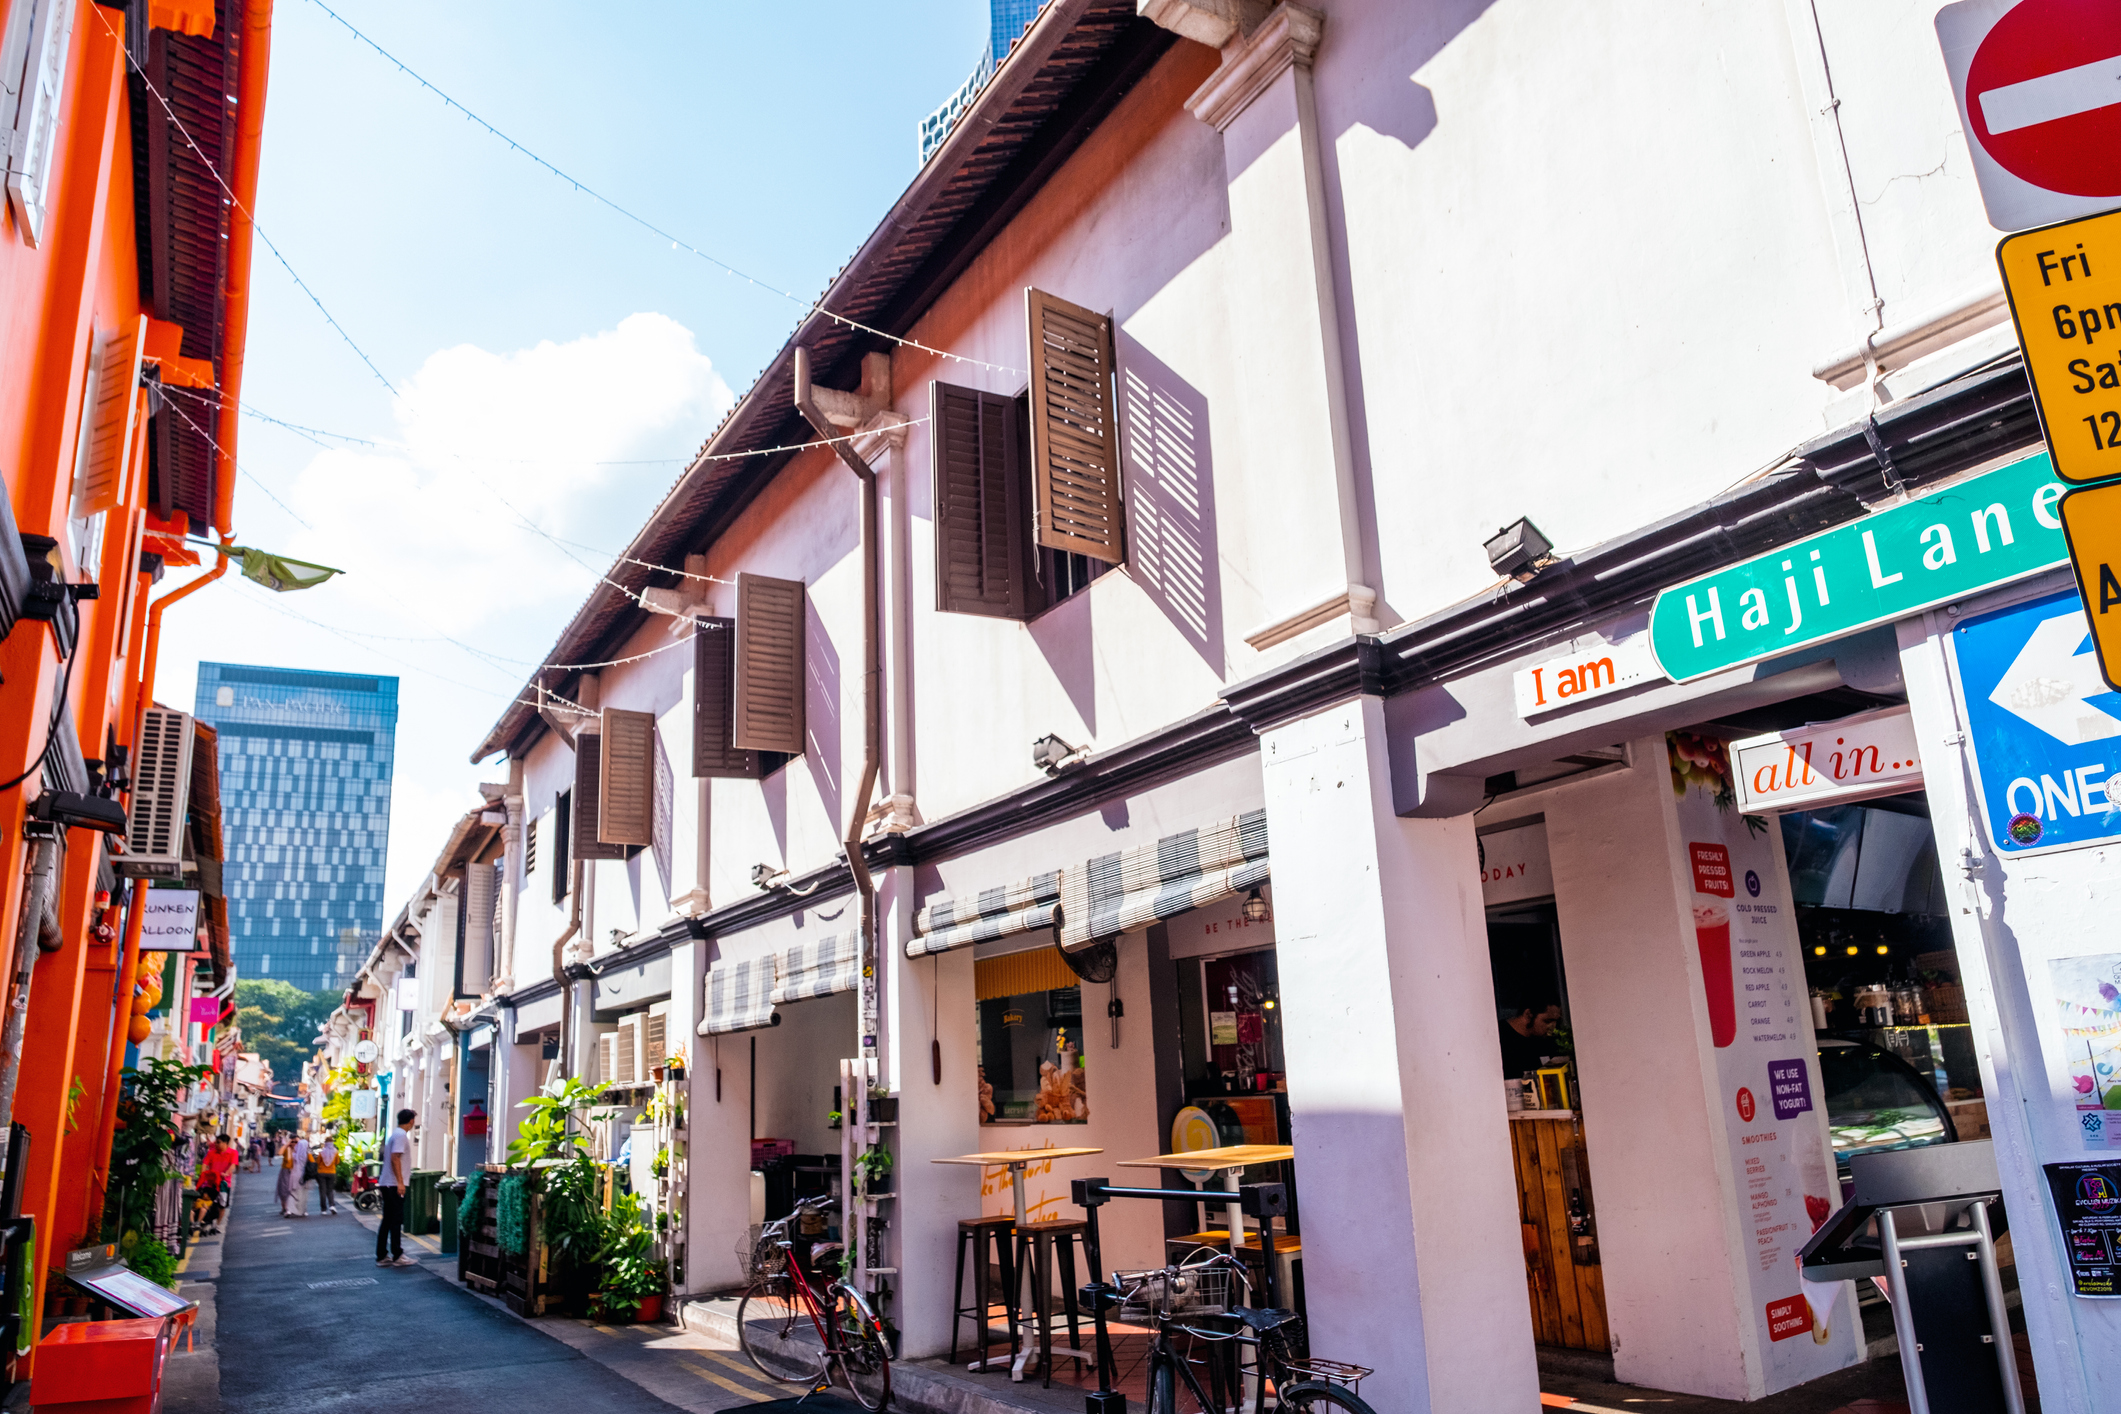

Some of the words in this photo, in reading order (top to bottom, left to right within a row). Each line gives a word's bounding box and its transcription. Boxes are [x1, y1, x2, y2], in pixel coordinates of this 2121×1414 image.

[2036, 243, 2091, 286] Fri
[2068, 349, 2121, 394] Sa
[1685, 549, 1830, 648] Haji
[1862, 482, 2068, 590] Lane
[1532, 667, 1547, 706] I
[243, 696, 276, 711] PAN
[284, 699, 348, 716] PACIFIC
[1753, 741, 1815, 793] all
[1829, 737, 1921, 780] in..
[2006, 764, 2106, 821] ONE
[1697, 850, 1723, 862] FRESHLY
[1481, 863, 1525, 883] ODAY
[1699, 865, 1726, 876] PRESSED
[1704, 879, 1729, 891] FRUITS!
[144, 904, 195, 914] UNKEN
[1736, 904, 1752, 913] COLD
[1753, 905, 1777, 914] PRESSED
[1205, 922, 1218, 934] BE
[1227, 916, 1250, 930] THE
[1751, 916, 1767, 925] JUICE
[141, 926, 194, 935] ALLOON
[1740, 950, 1756, 958] GREEN
[1757, 950, 1771, 958] APPLE
[1755, 983, 1770, 991] APPLE
[1748, 1000, 1767, 1008] CARROT
[1003, 1014, 1023, 1024] Bakery
[1750, 1017, 1771, 1025] ORANGE
[1753, 1033, 1786, 1042] WATERMELON
[1774, 1070, 1786, 1080] WE
[1786, 1068, 1799, 1079] USE
[1776, 1083, 1802, 1095] NON-FAT
[1778, 1099, 1807, 1110] YOGURT!
[1742, 1132, 1777, 1145] SMOOTHIES
[1745, 1157, 1760, 1165] MIXED
[1746, 1165, 1765, 1174] BERRIES
[1750, 1191, 1769, 1201] MANGO
[1756, 1223, 1788, 1236] PASSIONFRUIT
[1757, 1236, 1773, 1245] PEACH
[72, 1251, 92, 1262] Welcome
[1770, 1304, 1792, 1319] SIMPLY
[1773, 1316, 1803, 1334] SOOTHING
